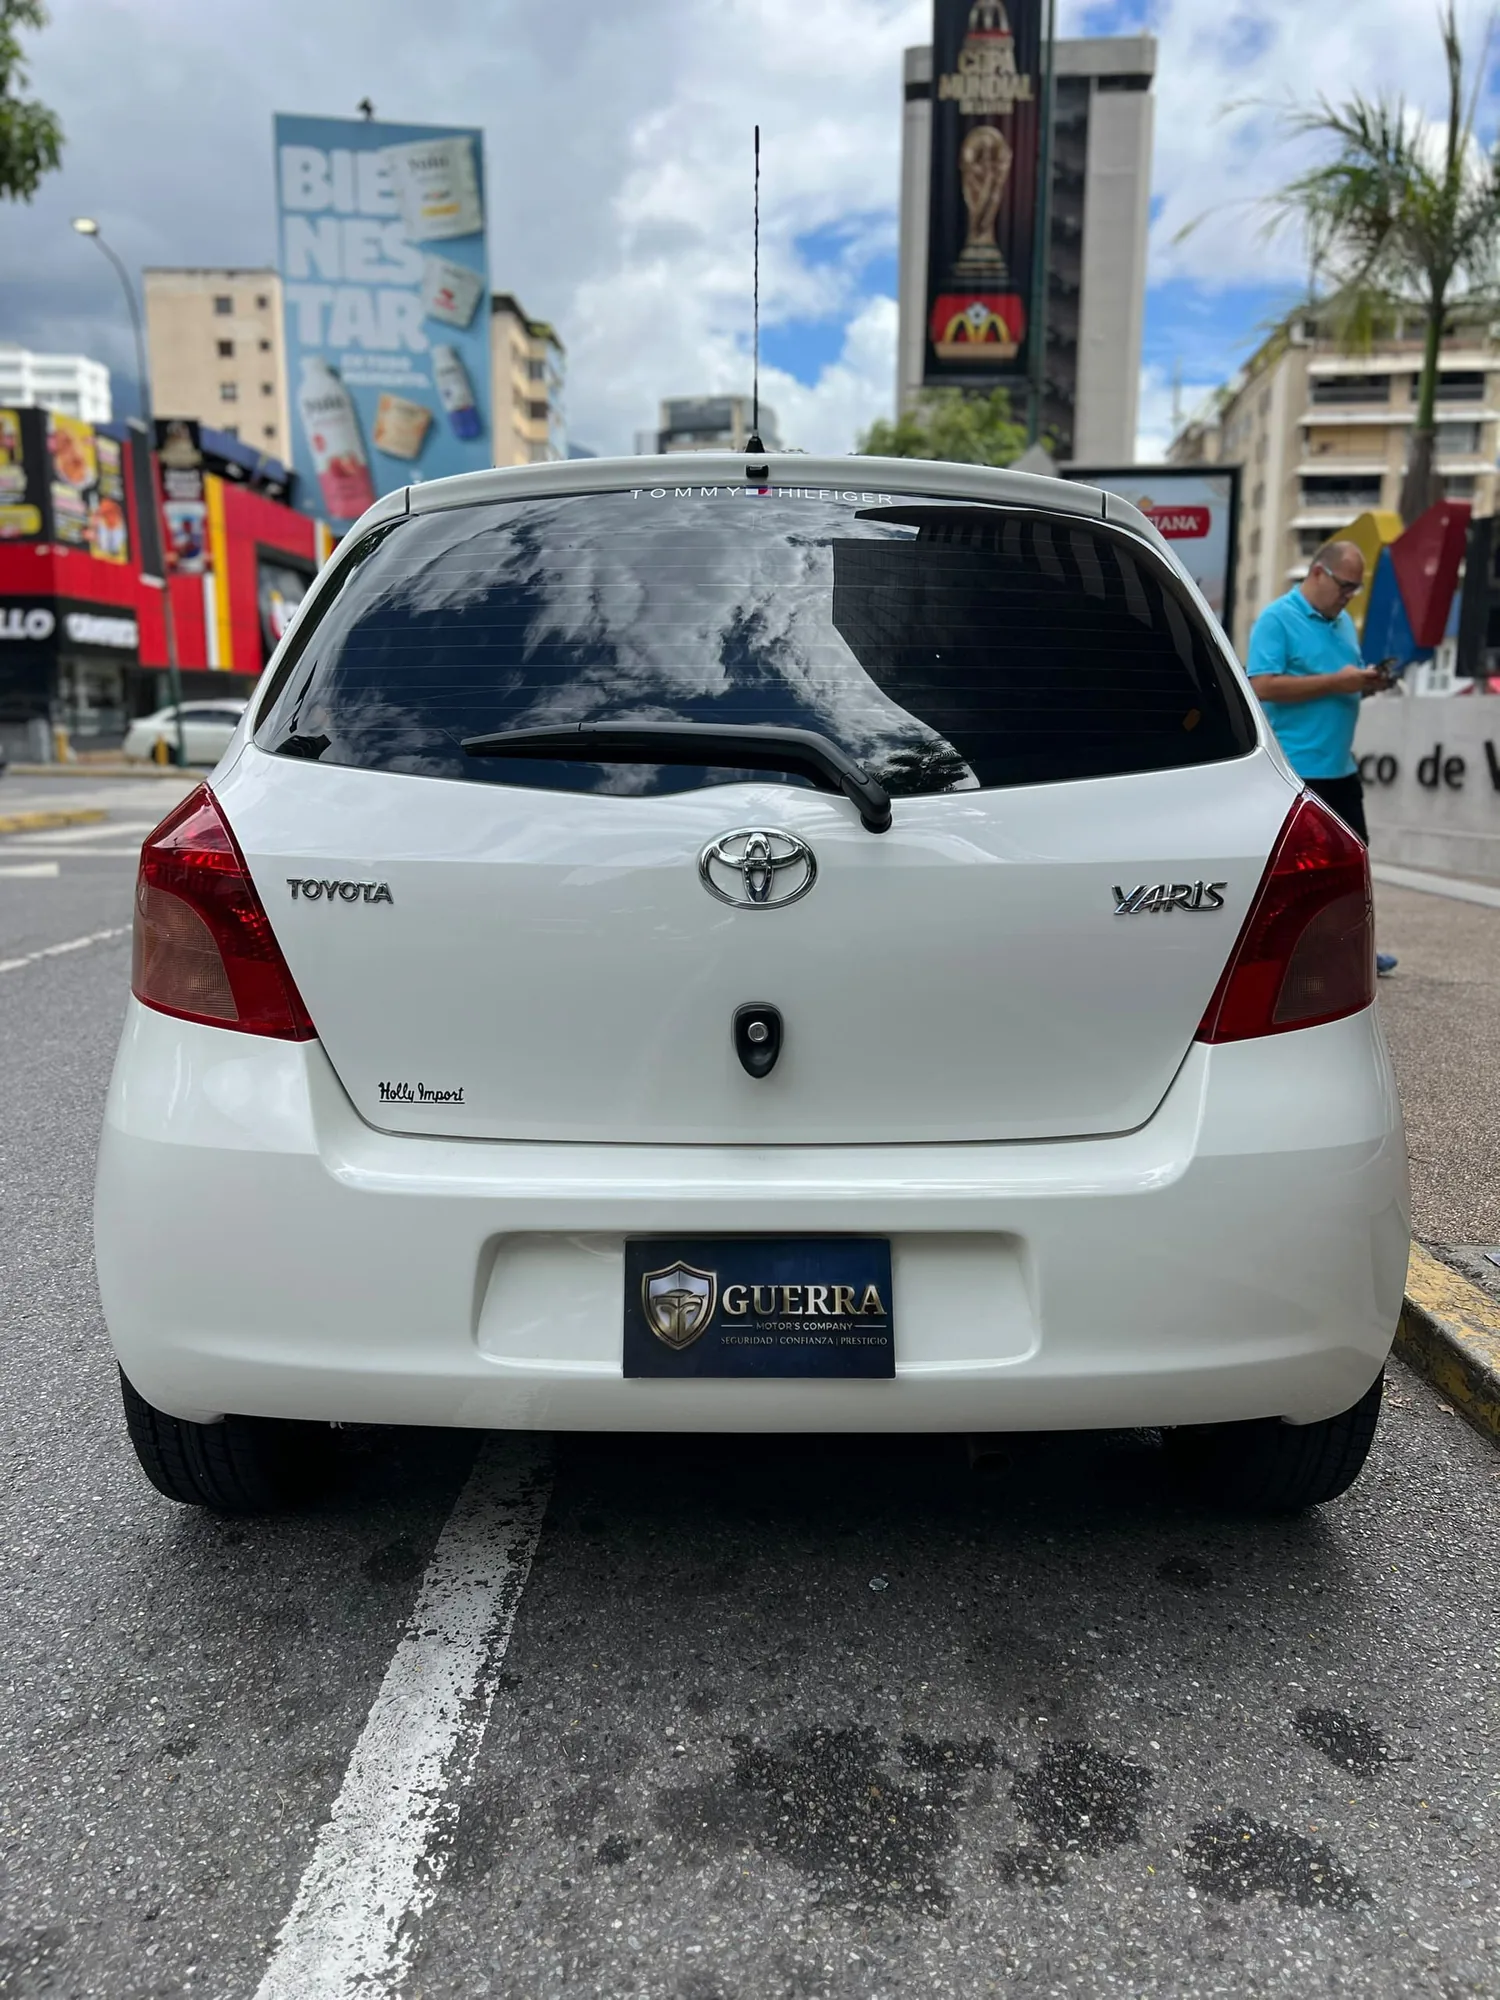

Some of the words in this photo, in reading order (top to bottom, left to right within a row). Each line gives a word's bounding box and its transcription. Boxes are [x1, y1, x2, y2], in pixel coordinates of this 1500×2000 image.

[284, 215, 424, 284] NES
[286, 284, 431, 353] TAR
[630, 486, 740, 499] TOMMY
[778, 488, 893, 505] HILFIGER
[1417, 742, 1466, 790] de
[286, 878, 394, 904] TOYOTA
[1111, 880, 1228, 914] YARIS
[378, 1081, 414, 1103] Holly
[418, 1082, 464, 1103] Import
[722, 1284, 887, 1316] GUERRA
[721, 1337, 773, 1345] SEGURIDAD
[780, 1337, 834, 1345] CONFIANZA
[841, 1337, 887, 1345] PRESTIGIO
[756, 1322, 801, 1331] MOTOR'S
[803, 1322, 853, 1331] COMPANY
